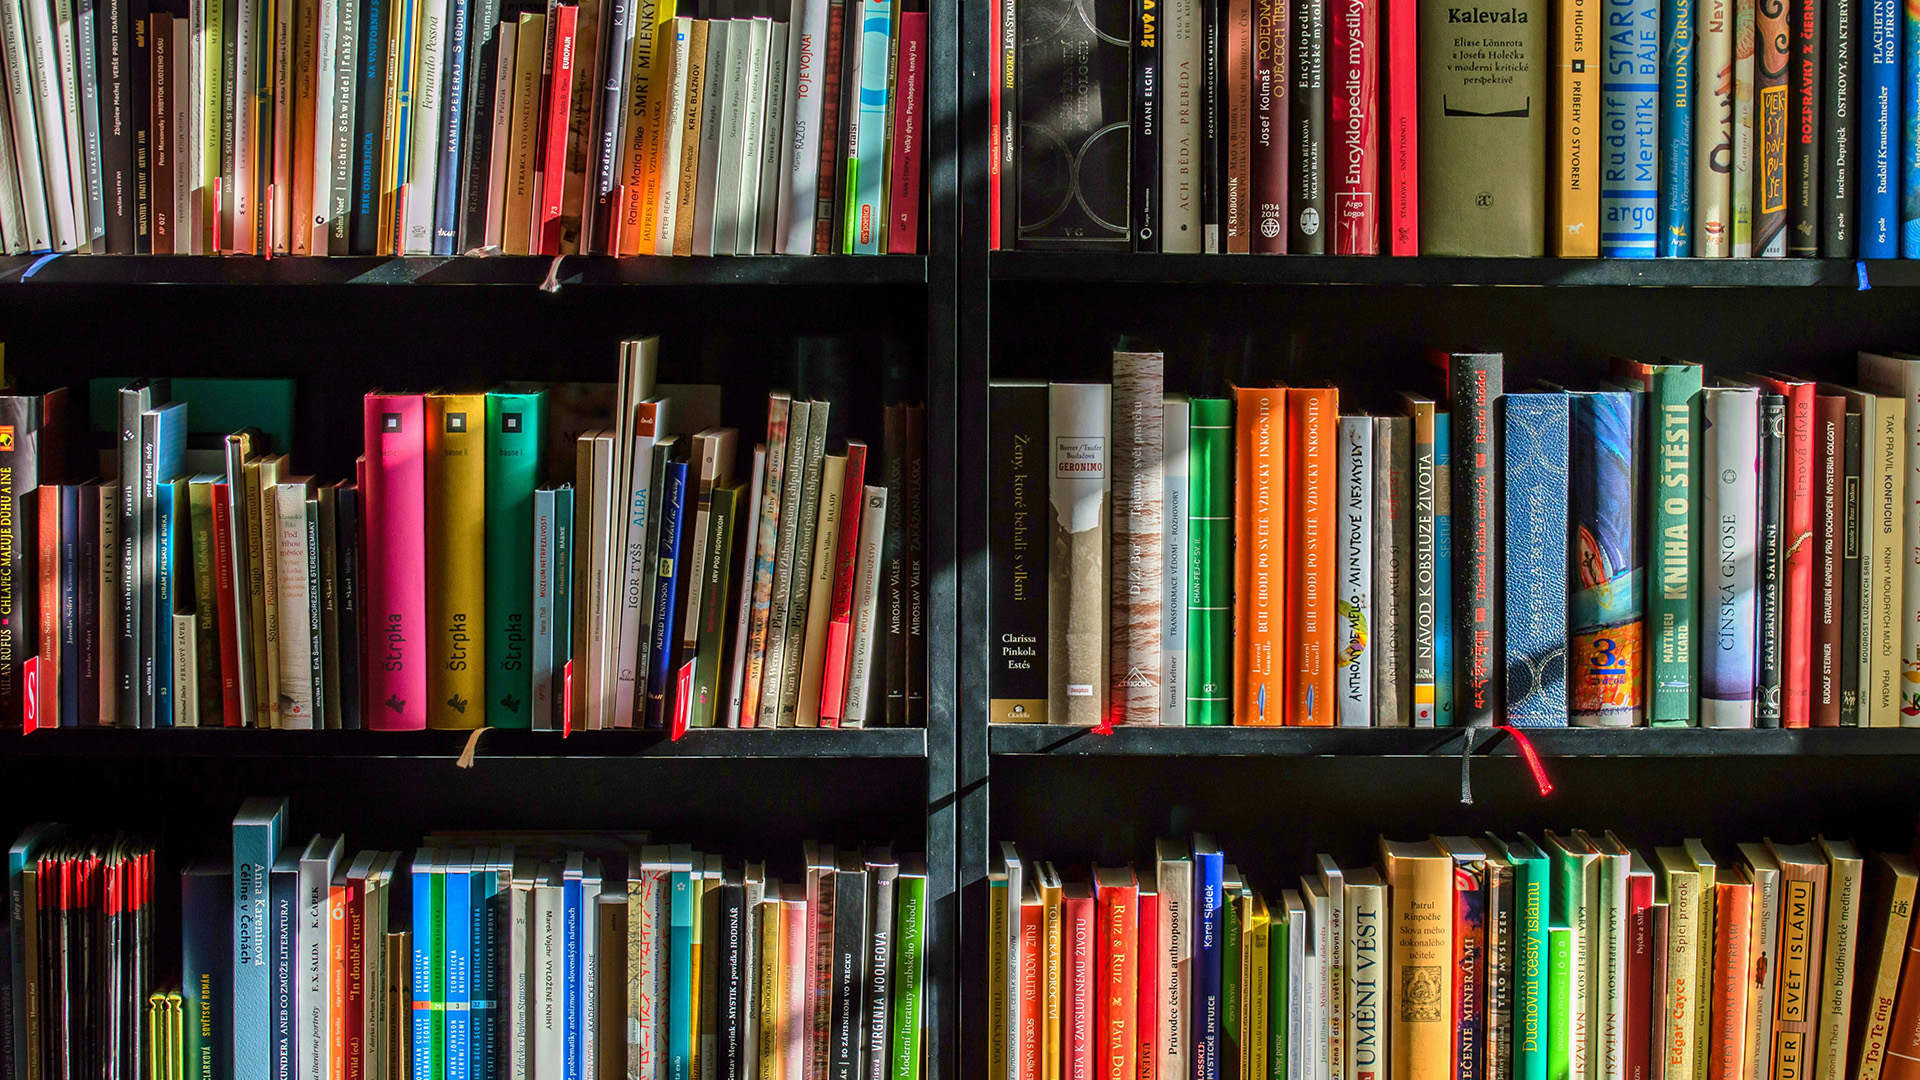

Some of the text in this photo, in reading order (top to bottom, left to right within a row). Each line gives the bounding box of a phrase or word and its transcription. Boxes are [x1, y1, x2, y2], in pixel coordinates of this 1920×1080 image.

[1142, 14, 1155, 48] ŽIVÝ
[1299, 4, 1310, 88] Encyklopedie
[1448, 8, 1528, 24] Kalevala
[1454, 38, 1523, 47] Eliase Lönnrota
[1636, 8, 1657, 74] BÁJE A
[423, 16, 437, 110] Fernando Pessoa
[448, 8, 464, 152] KAMIL PETERAJ S tebou
[562, 37, 571, 69] EUROPAIN
[1455, 62, 1493, 71] moderní
[1495, 62, 1528, 72] kritické
[1460, 50, 1486, 60] Josefa
[1489, 50, 1524, 60] Holečka
[1464, 76, 1513, 86] perspektivě
[1673, 43, 1688, 108] BLUDNÝ
[362, 8, 378, 214] ERIK ONDREJIČKA NA VNÚTORNEJ
[627, 0, 655, 225] Rainer Maria Rilke SMRŤ MILENKY
[1144, 101, 1152, 135] DUANE
[1260, 69, 1270, 146] Josef Kolmaš
[1345, 0, 1364, 184] Encyklopedie mystiky
[89, 132, 97, 174] MAZANEC
[1178, 60, 1190, 211] ACH BĚDA, PŘEBĚDA
[1606, 97, 1626, 181] Rudolf
[1635, 97, 1653, 181] Mertlík
[1607, 207, 1654, 229] argo
[1059, 462, 1102, 471] GERONIMO
[160, 514, 168, 537] BÚRKA
[1662, 404, 1689, 599] KNIHA O ŠTĚSTÍ
[628, 488, 647, 609] IGOR TYŠŠ ALBA
[1416, 454, 1432, 658] NÁVOD K OBSLUZE ŽIVOTA
[1476, 476, 1488, 600] Tibetská kniha mrtvých
[1881, 414, 1895, 708] TAK PRAVIL KONFUCIUS KNIHY MOUDRÝCH MUŽŮ PRAGMA
[701, 685, 708, 694] 39
[714, 515, 724, 555] FIGOVNÍKOM
[890, 559, 901, 634] MIROSLAV VÁLEK
[909, 560, 921, 635] MIROSLAV VÁLEK
[1717, 514, 1736, 650] ČÍNSKÁ GNOSE
[178, 621, 186, 645] ZÁVES
[382, 613, 406, 671] Štrpka
[445, 613, 470, 671] Štrpka
[501, 613, 525, 671] Štrpka
[1002, 633, 1036, 643] Clarissa
[1002, 647, 1036, 656] Pinkola
[1008, 660, 1030, 669] Estés
[1591, 638, 1626, 667] 3.
[1663, 613, 1674, 663] MATTHIEU
[1677, 625, 1688, 663] RICARD
[240, 864, 251, 900] Céline
[1204, 885, 1214, 919] Sládek
[1411, 901, 1435, 909] Patrul
[1760, 882, 1771, 945] Robin Sharma
[240, 915, 253, 964] Čechách
[255, 864, 266, 966] Anna Kareninová
[1074, 918, 1086, 956] ŽIVOTU
[1204, 921, 1213, 947] Karel
[278, 900, 288, 1035] ANEB CO ZMŮŽE LITERATURA?
[1461, 938, 1474, 1021] MINERÁLMI
[1522, 882, 1541, 1052] Duchovní cesty islámu
[1784, 887, 1806, 1015] SVĚT ISLÁMU
[872, 932, 886, 1051] VIRGINIA WOOLFOVÁ
[900, 899, 917, 1077] Moderní literatury arabského Východu
[1073, 961, 1086, 1040] ZMYSLUPLNÉMU
[1351, 906, 1376, 1067] UMĚNÍ VÉST
[1205, 1036, 1214, 1080] MYSTICKÉ
[1274, 1035, 1282, 1075] Moje peníze
